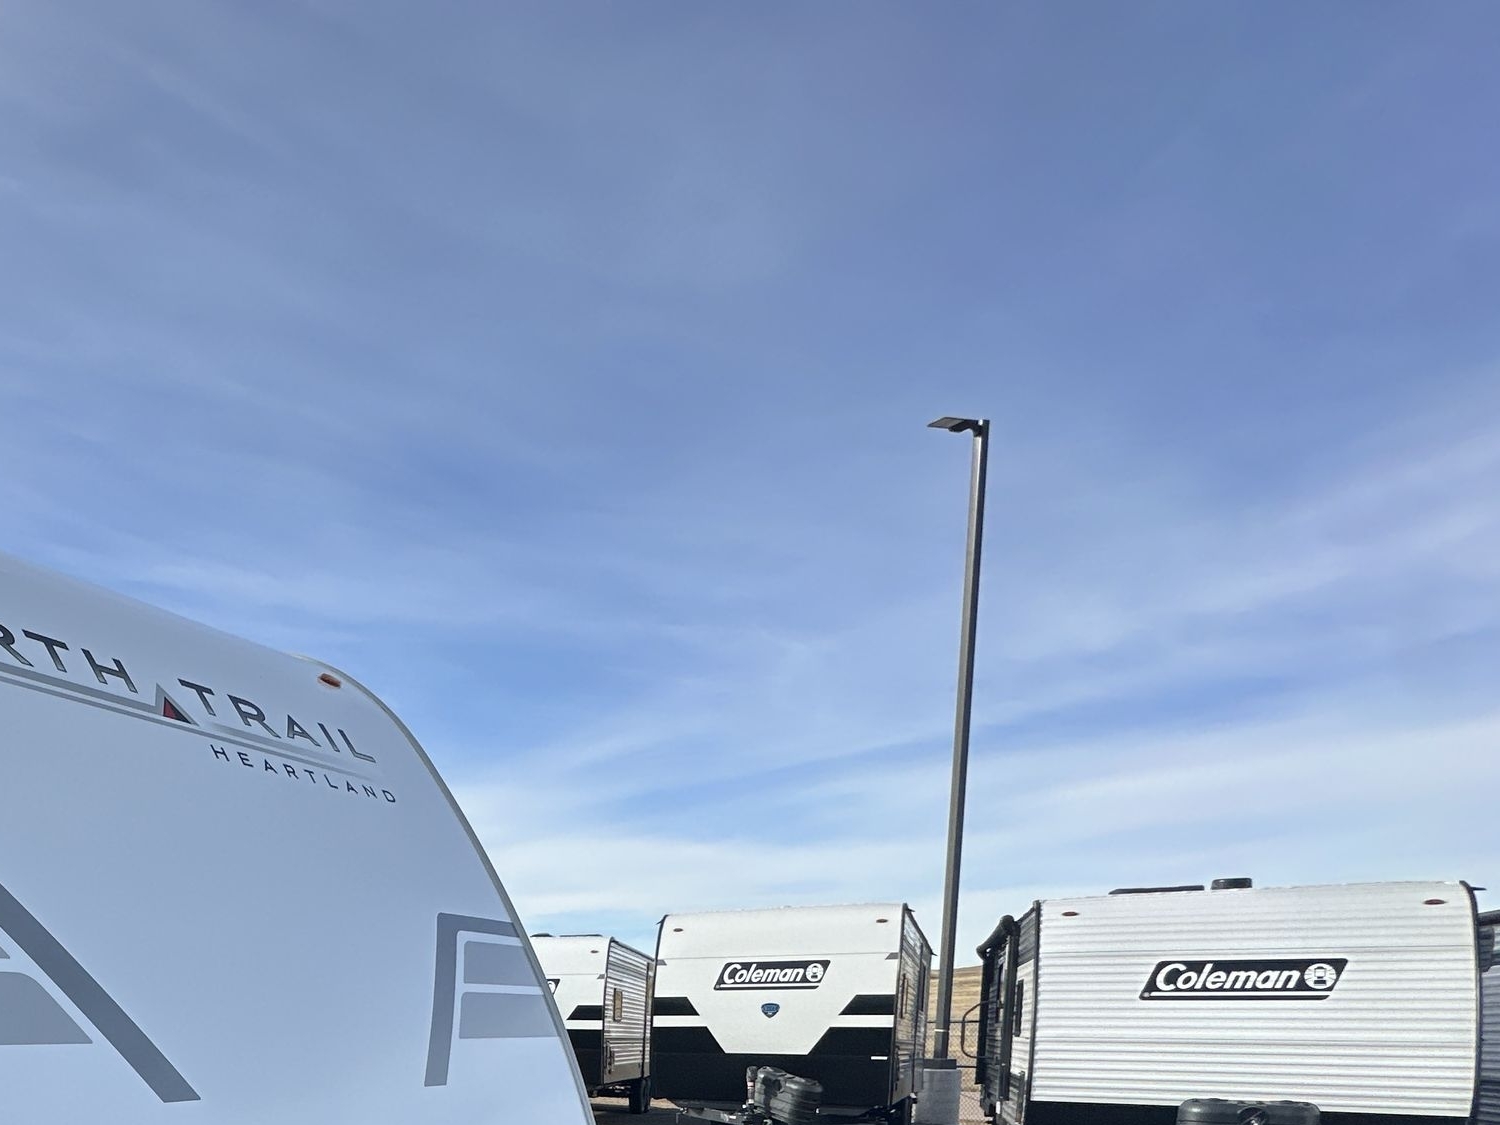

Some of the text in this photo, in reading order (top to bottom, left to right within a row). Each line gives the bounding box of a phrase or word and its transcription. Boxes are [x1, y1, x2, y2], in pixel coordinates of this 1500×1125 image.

[178, 679, 376, 763] TRAIL
[210, 744, 396, 803] HEARTLAND
[723, 963, 804, 984] Coleman
[1155, 963, 1301, 991] Coleman
